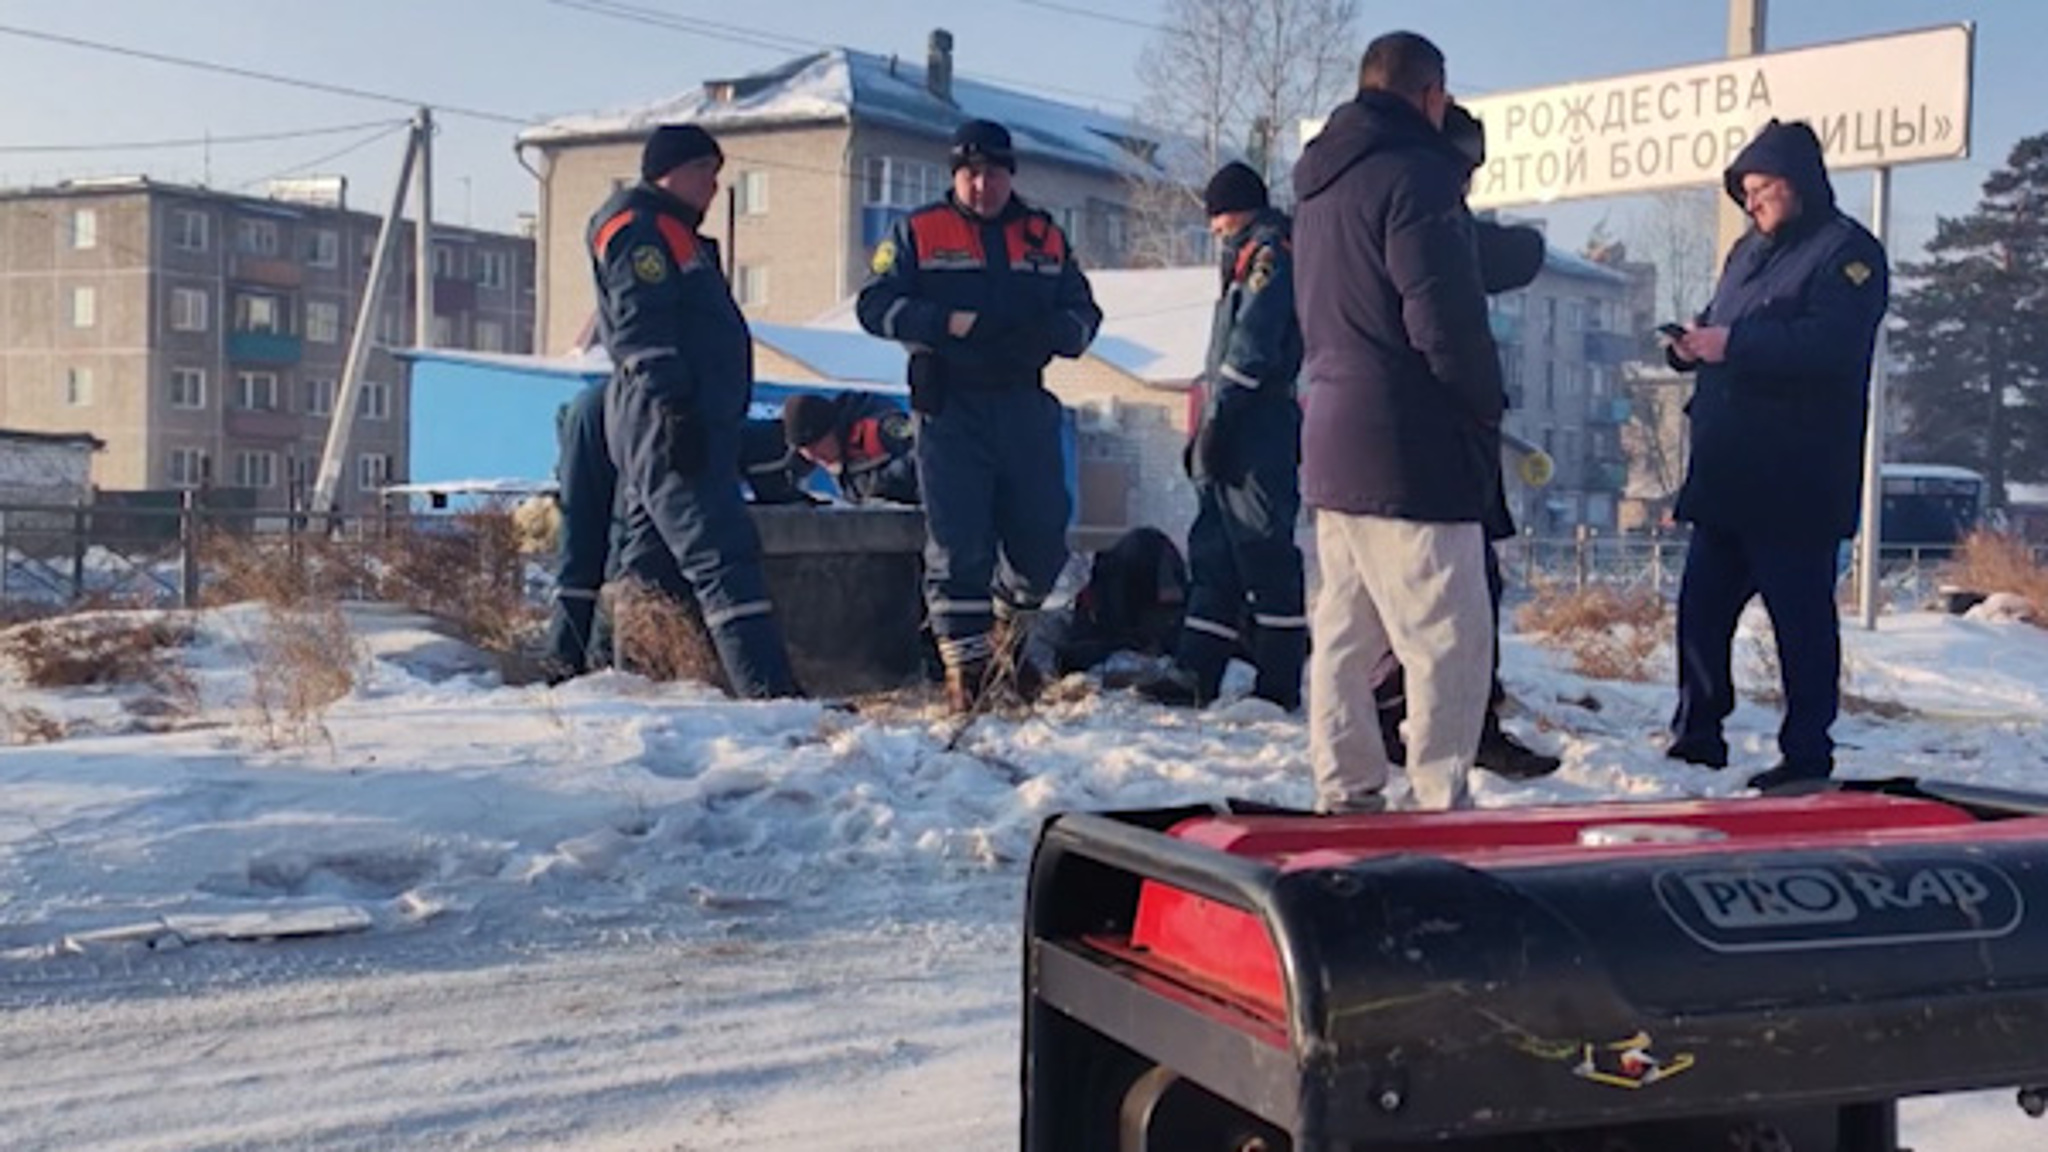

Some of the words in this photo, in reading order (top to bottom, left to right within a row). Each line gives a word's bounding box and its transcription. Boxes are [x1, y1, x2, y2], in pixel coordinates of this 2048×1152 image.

[1504, 69, 1772, 142] РОЖДЕСТВА
[1473, 135, 1588, 196] ЯТОЙ
[1609, 104, 1953, 181] БОГОРИЦЫ»
